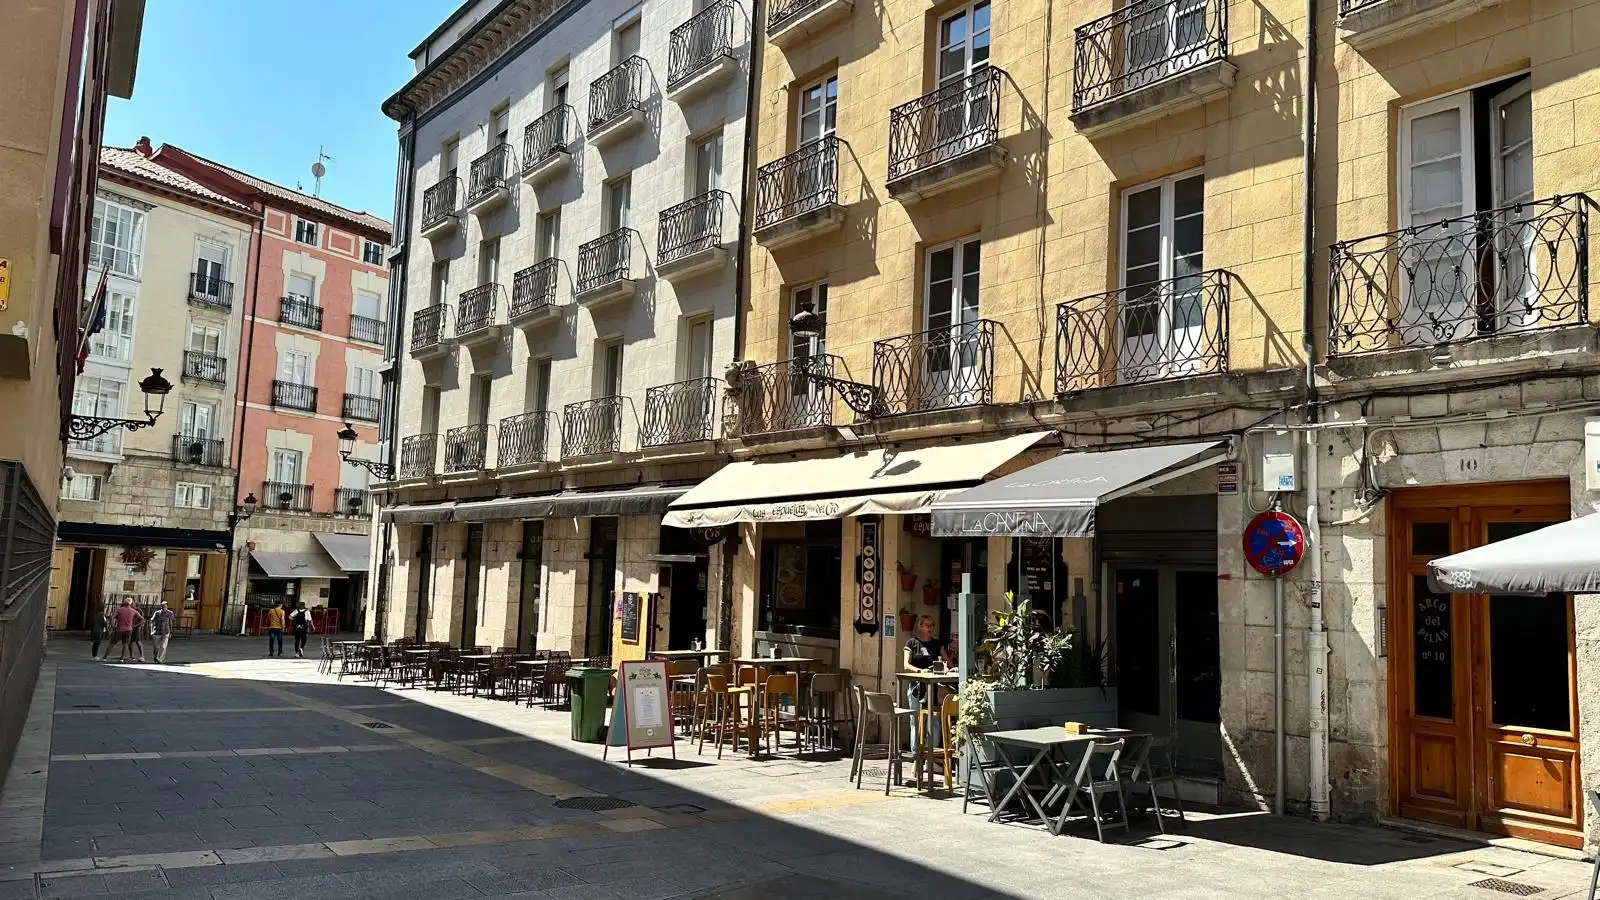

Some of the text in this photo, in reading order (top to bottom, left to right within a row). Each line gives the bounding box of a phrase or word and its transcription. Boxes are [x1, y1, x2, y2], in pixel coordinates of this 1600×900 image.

[1460, 458, 1478, 471] 10
[983, 511, 1052, 533] CANTINA
[1418, 598, 1447, 612] ARCO
[1424, 615, 1441, 626] del
[1416, 627, 1449, 644] PILAR
[1434, 651, 1445, 661] 10
